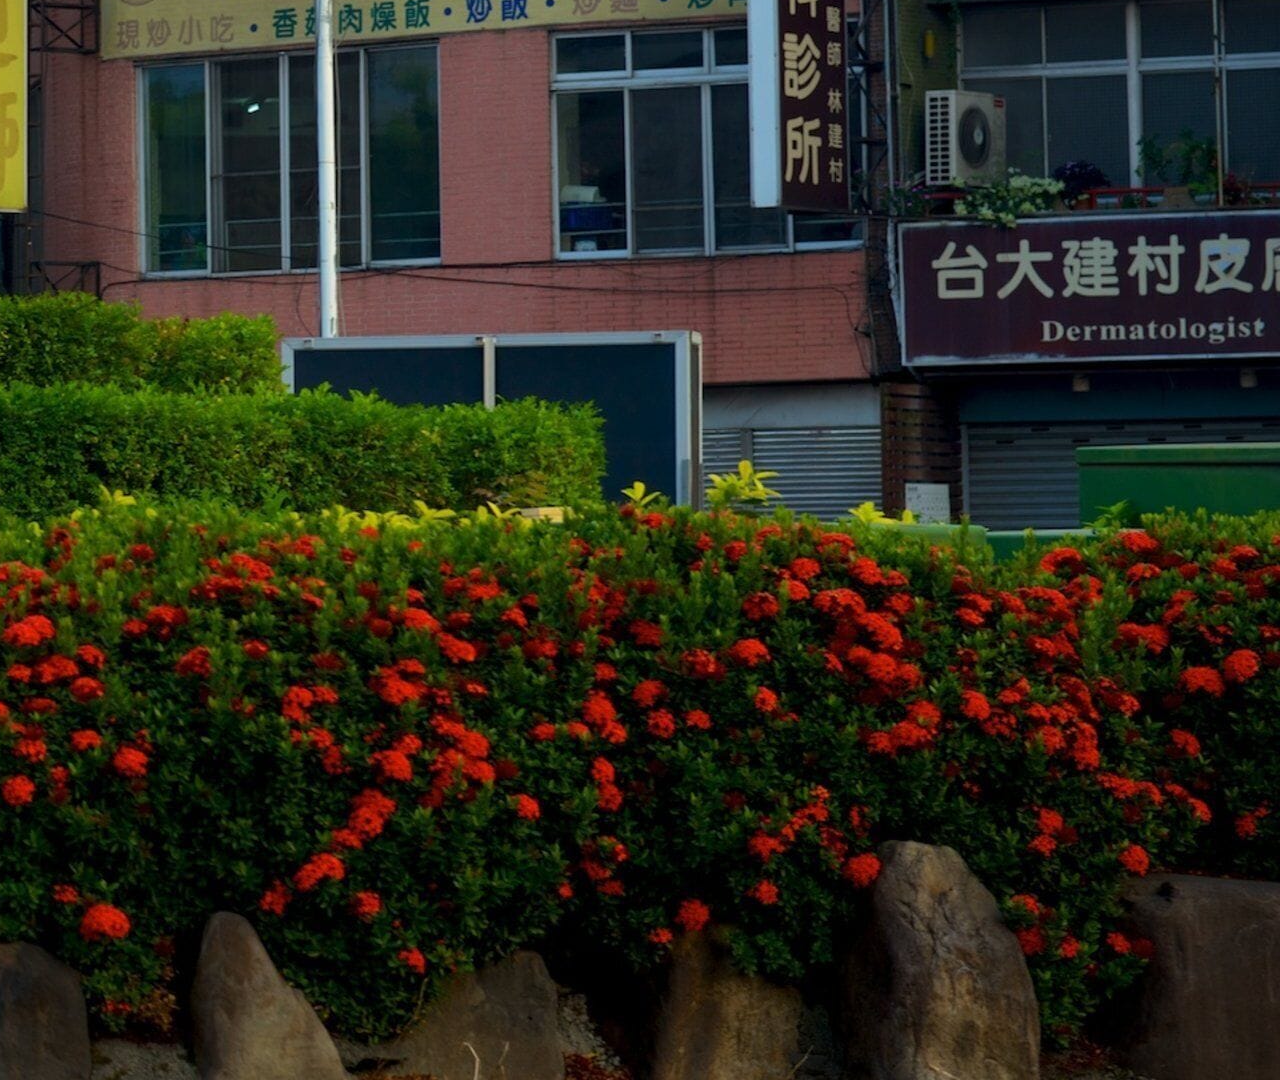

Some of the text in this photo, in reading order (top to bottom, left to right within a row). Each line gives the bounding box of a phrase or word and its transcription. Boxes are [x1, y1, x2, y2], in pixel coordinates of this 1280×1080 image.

[114, 13, 236, 50] 現炒小吃
[826, 86, 844, 183] 林建村
[1040, 316, 1265, 344] Dermatologist
